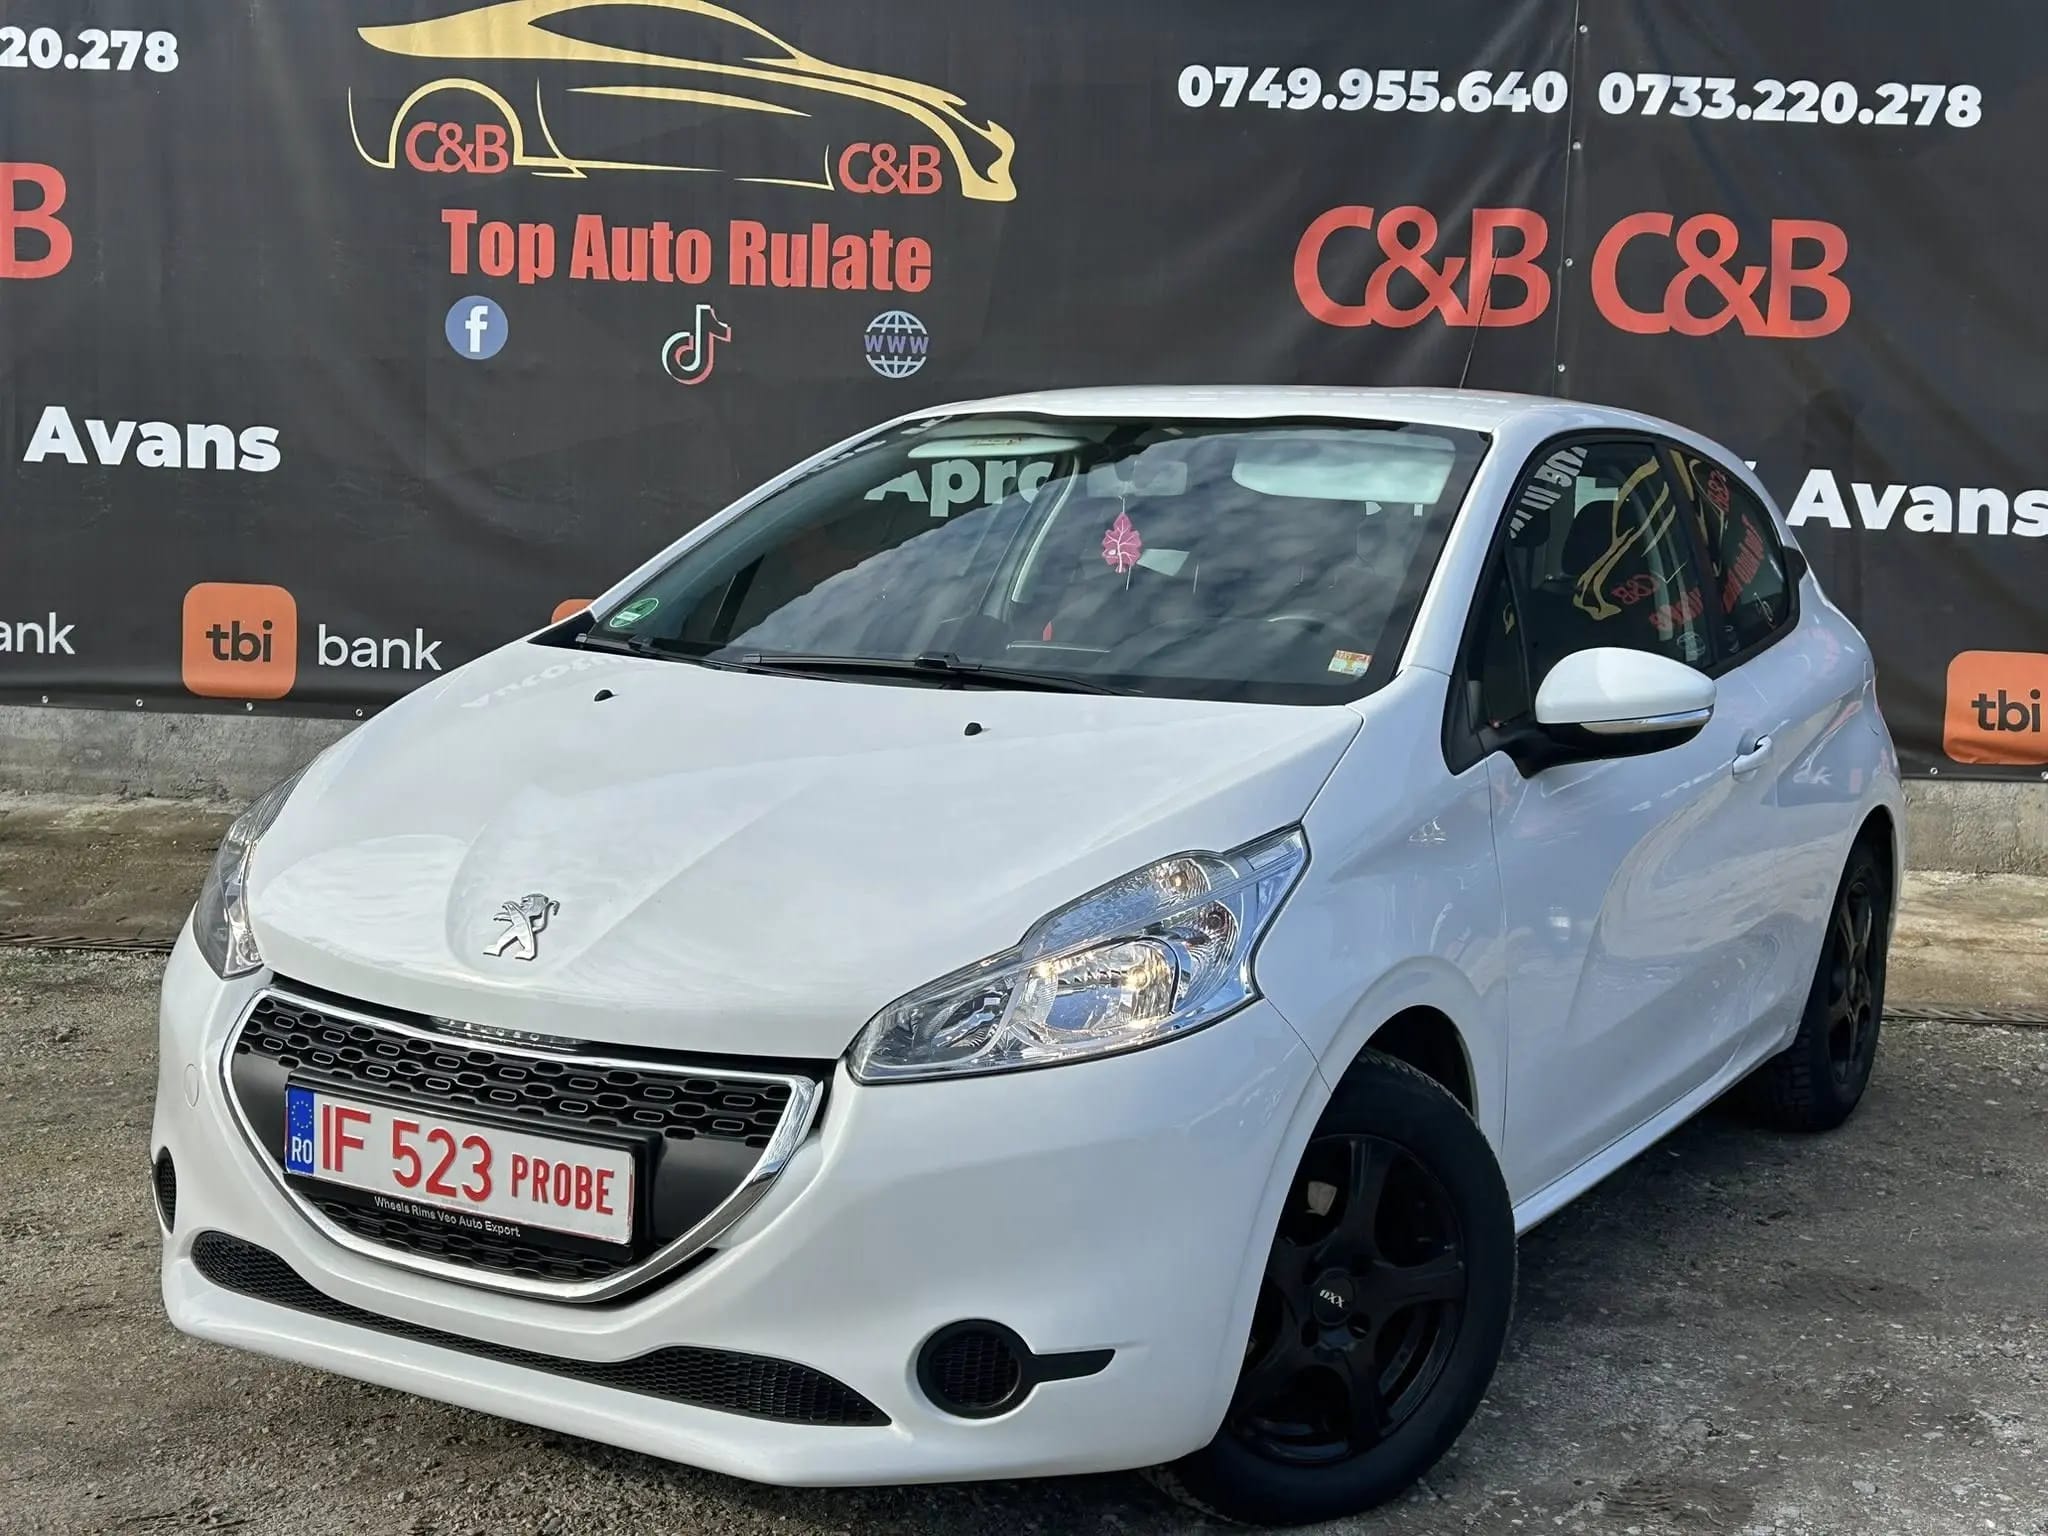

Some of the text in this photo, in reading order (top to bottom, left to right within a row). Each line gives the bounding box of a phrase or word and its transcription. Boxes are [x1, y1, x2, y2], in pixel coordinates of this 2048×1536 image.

[0, 26, 179, 73] 20.278
[1177, 64, 1568, 114] 0749.955.640
[1598, 71, 1982, 128] 0733.220.278
[404, 121, 511, 174] C&B
[838, 143, 942, 195] C&B
[441, 209, 933, 293] Top Auto Rulate
[1293, 205, 1551, 328] C&B
[1591, 212, 1852, 339] C&B
[23, 405, 281, 473] Avans
[1784, 468, 2048, 538] Avans
[205, 620, 442, 671] tbi bank
[1971, 689, 2041, 733] tbi
[291, 1135, 313, 1165] RO
[322, 1102, 615, 1217] IF 523 PROBE
[374, 1195, 410, 1215] Wheels
[412, 1204, 436, 1221] Rims
[458, 1215, 483, 1230] Auto
[485, 1220, 521, 1238] Export
